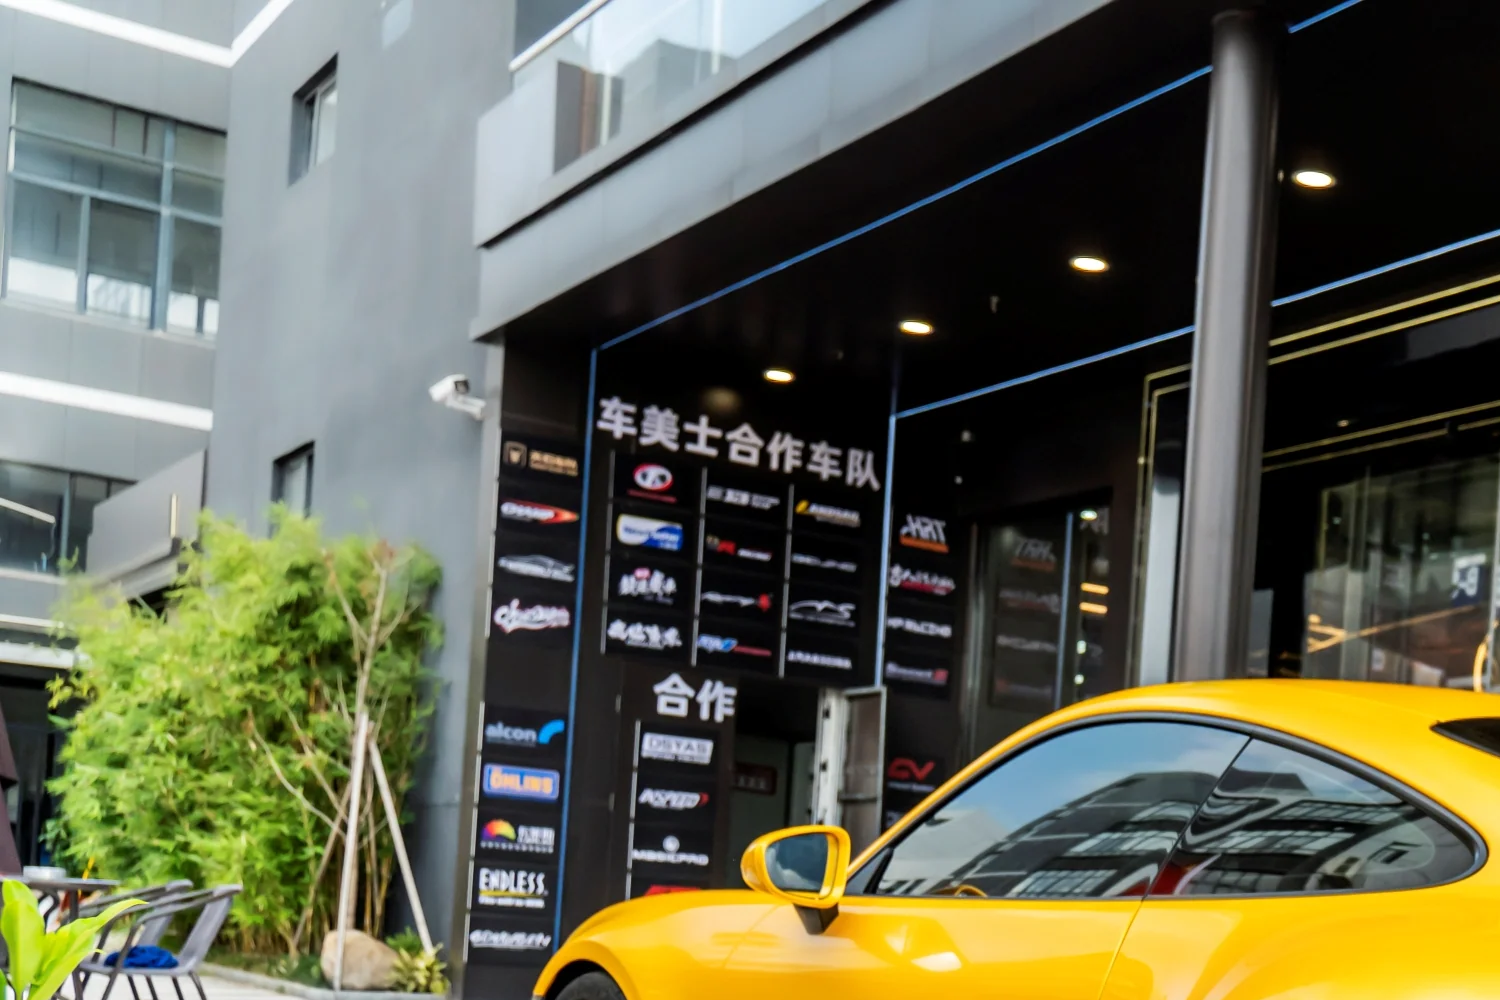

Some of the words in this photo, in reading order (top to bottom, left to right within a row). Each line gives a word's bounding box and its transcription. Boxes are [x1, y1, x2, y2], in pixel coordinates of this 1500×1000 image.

[597, 396, 881, 491] 车美士合作车队
[652, 673, 738, 723] 合作
[485, 722, 538, 743] alcon
[479, 868, 547, 896] ENDLESS
